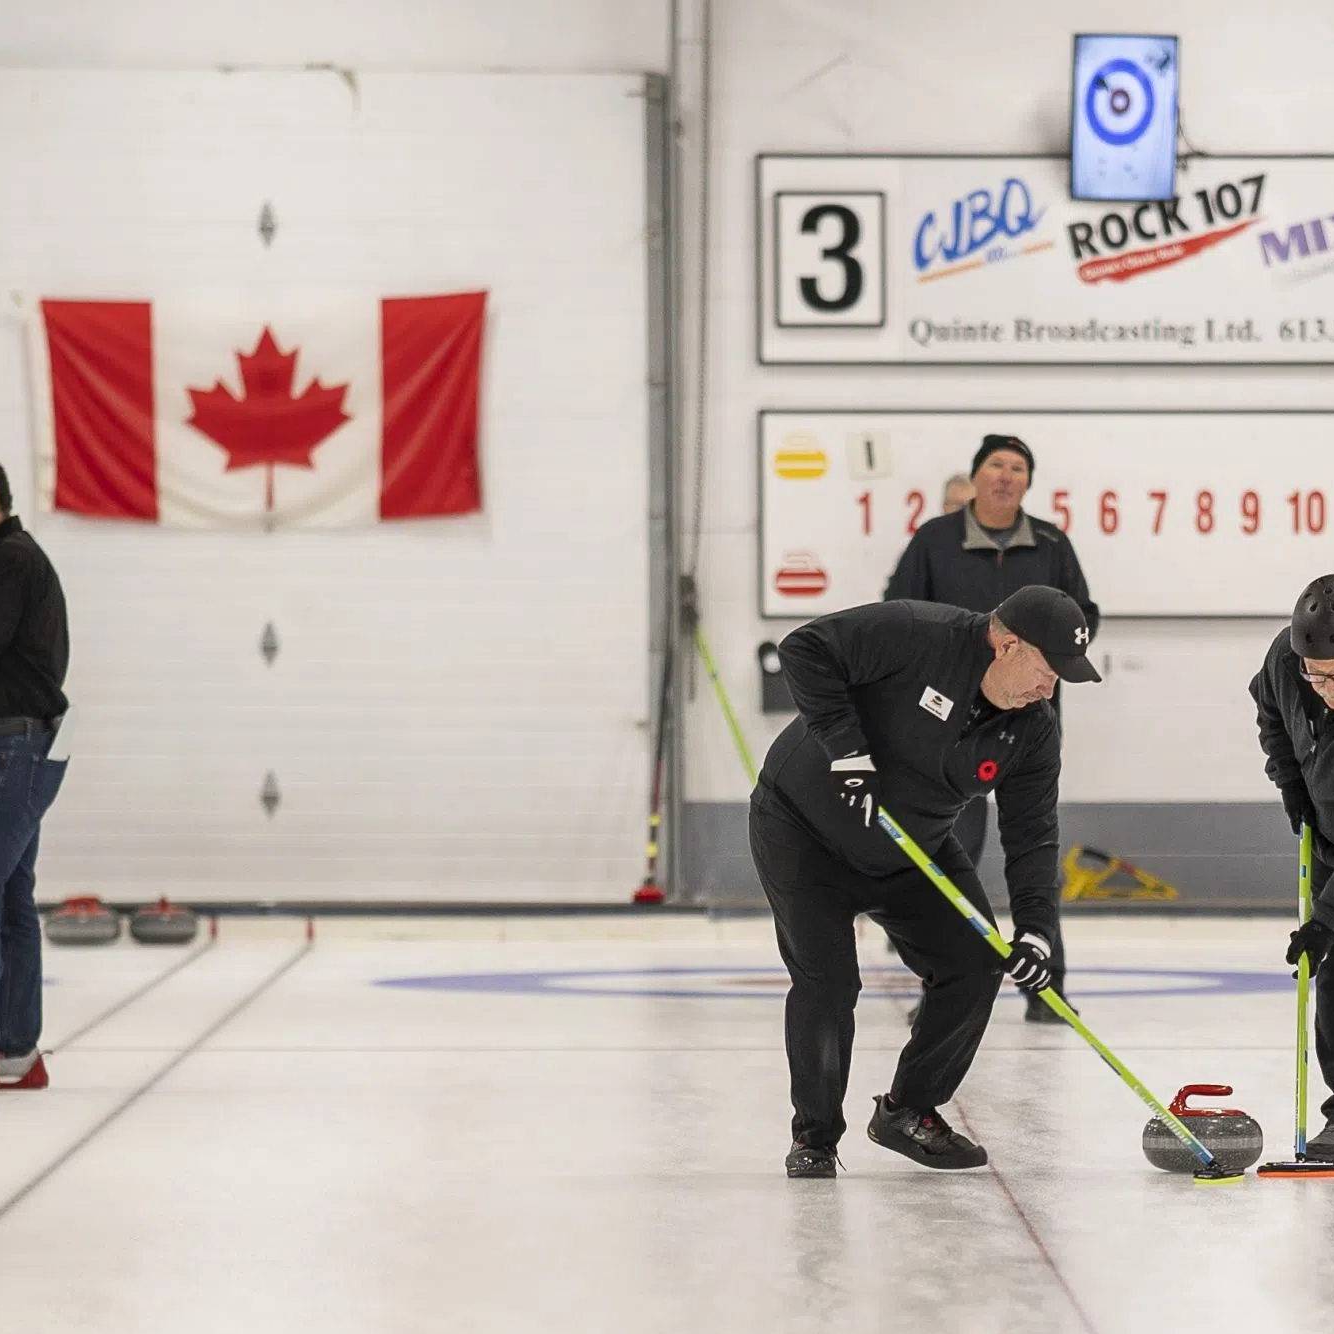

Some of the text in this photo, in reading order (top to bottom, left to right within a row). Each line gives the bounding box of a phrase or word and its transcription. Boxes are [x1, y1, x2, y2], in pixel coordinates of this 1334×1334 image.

[1067, 173, 1267, 262] ROCK 107
[799, 203, 863, 313] 3
[910, 319, 1004, 344] Quinte
[1015, 318, 1196, 346] Broadcasting
[1204, 320, 1262, 344] Ltd.
[856, 490, 873, 537] 1
[906, 490, 927, 536] 2
[1098, 490, 1120, 537] 6
[1147, 490, 1169, 535] 7
[1195, 489, 1217, 535] 8
[1240, 489, 1262, 535] 9
[1286, 489, 1327, 535] 10
